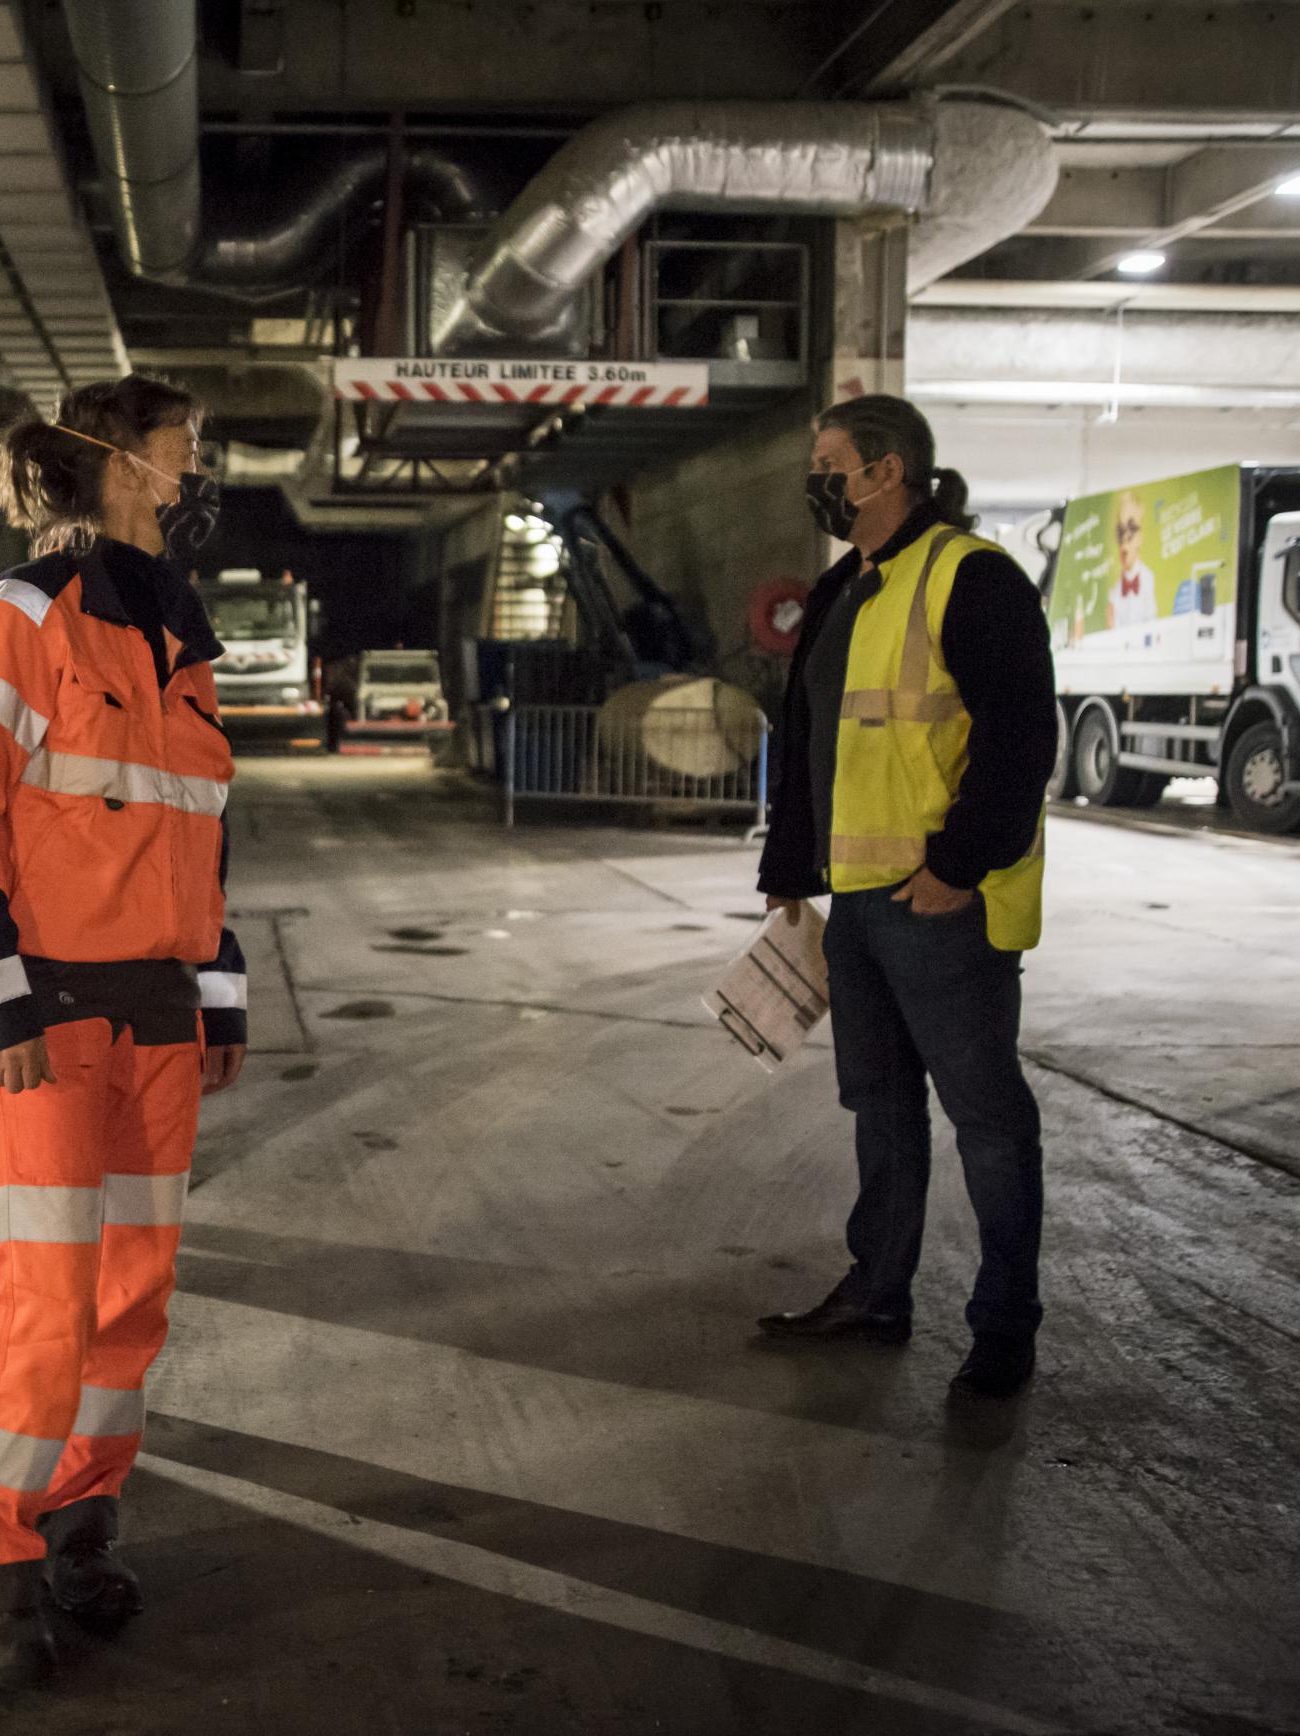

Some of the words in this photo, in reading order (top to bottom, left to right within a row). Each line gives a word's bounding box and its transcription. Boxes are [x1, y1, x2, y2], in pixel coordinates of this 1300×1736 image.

[396, 362, 489, 378] HAUTEUR
[500, 364, 576, 380] LIMITEE
[588, 365, 646, 381] 3.60m
